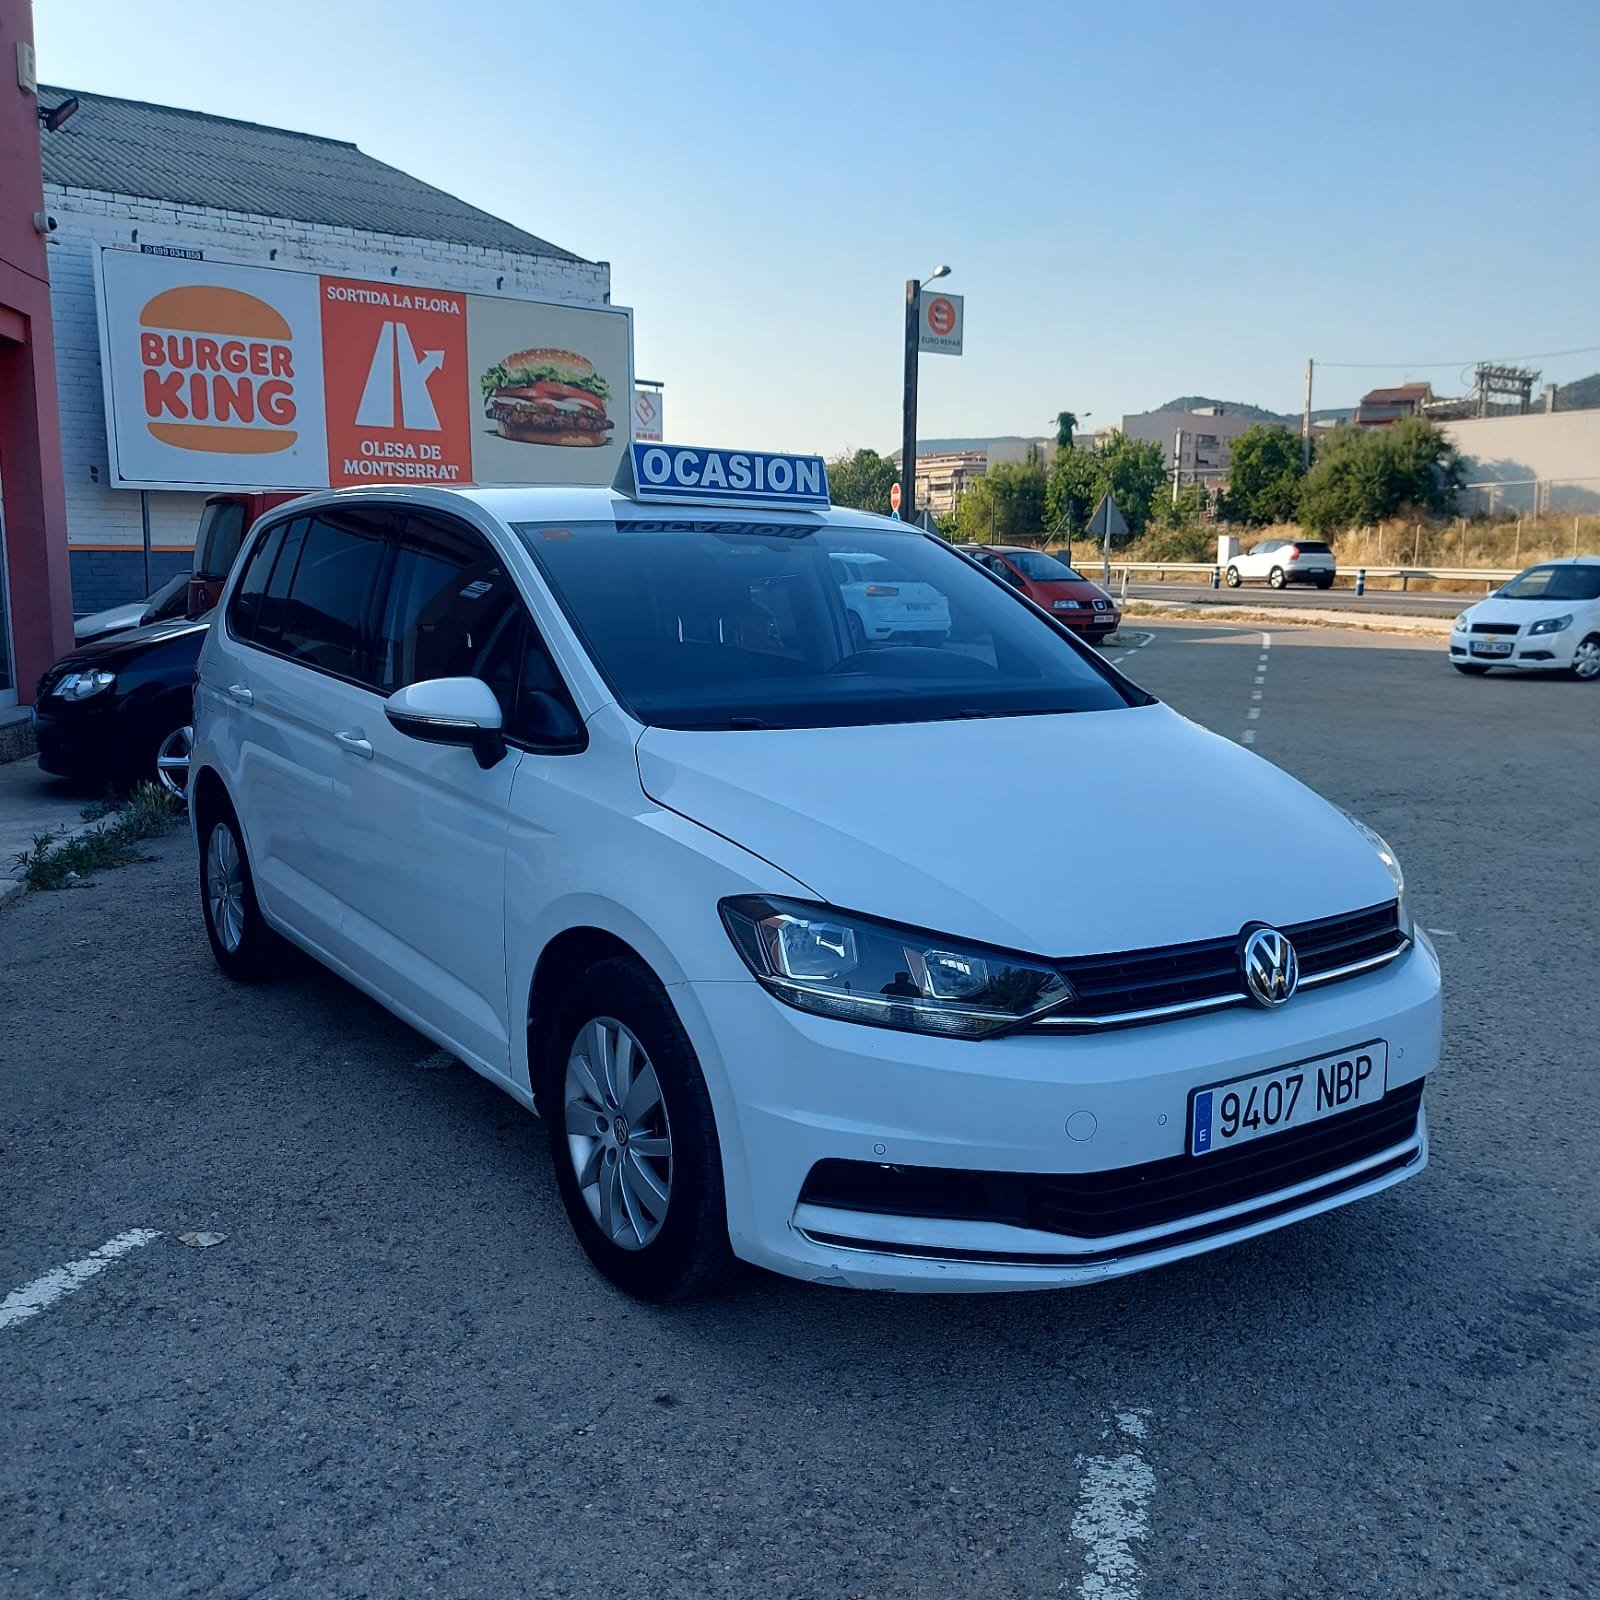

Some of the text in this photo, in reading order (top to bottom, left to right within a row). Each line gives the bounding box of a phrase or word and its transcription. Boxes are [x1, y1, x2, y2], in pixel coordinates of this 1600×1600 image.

[153, 246, 168, 256] 699
[170, 249, 184, 258] 034
[327, 286, 460, 314] SORTIDA LA FLORA
[140, 332, 295, 378] BURGER
[143, 369, 297, 426] KING
[360, 440, 442, 460] OLESA DE
[344, 459, 460, 480] MONTSERRAT
[642, 448, 820, 493] OCASION
[1199, 1054, 1372, 1142] E 9407 NBP
